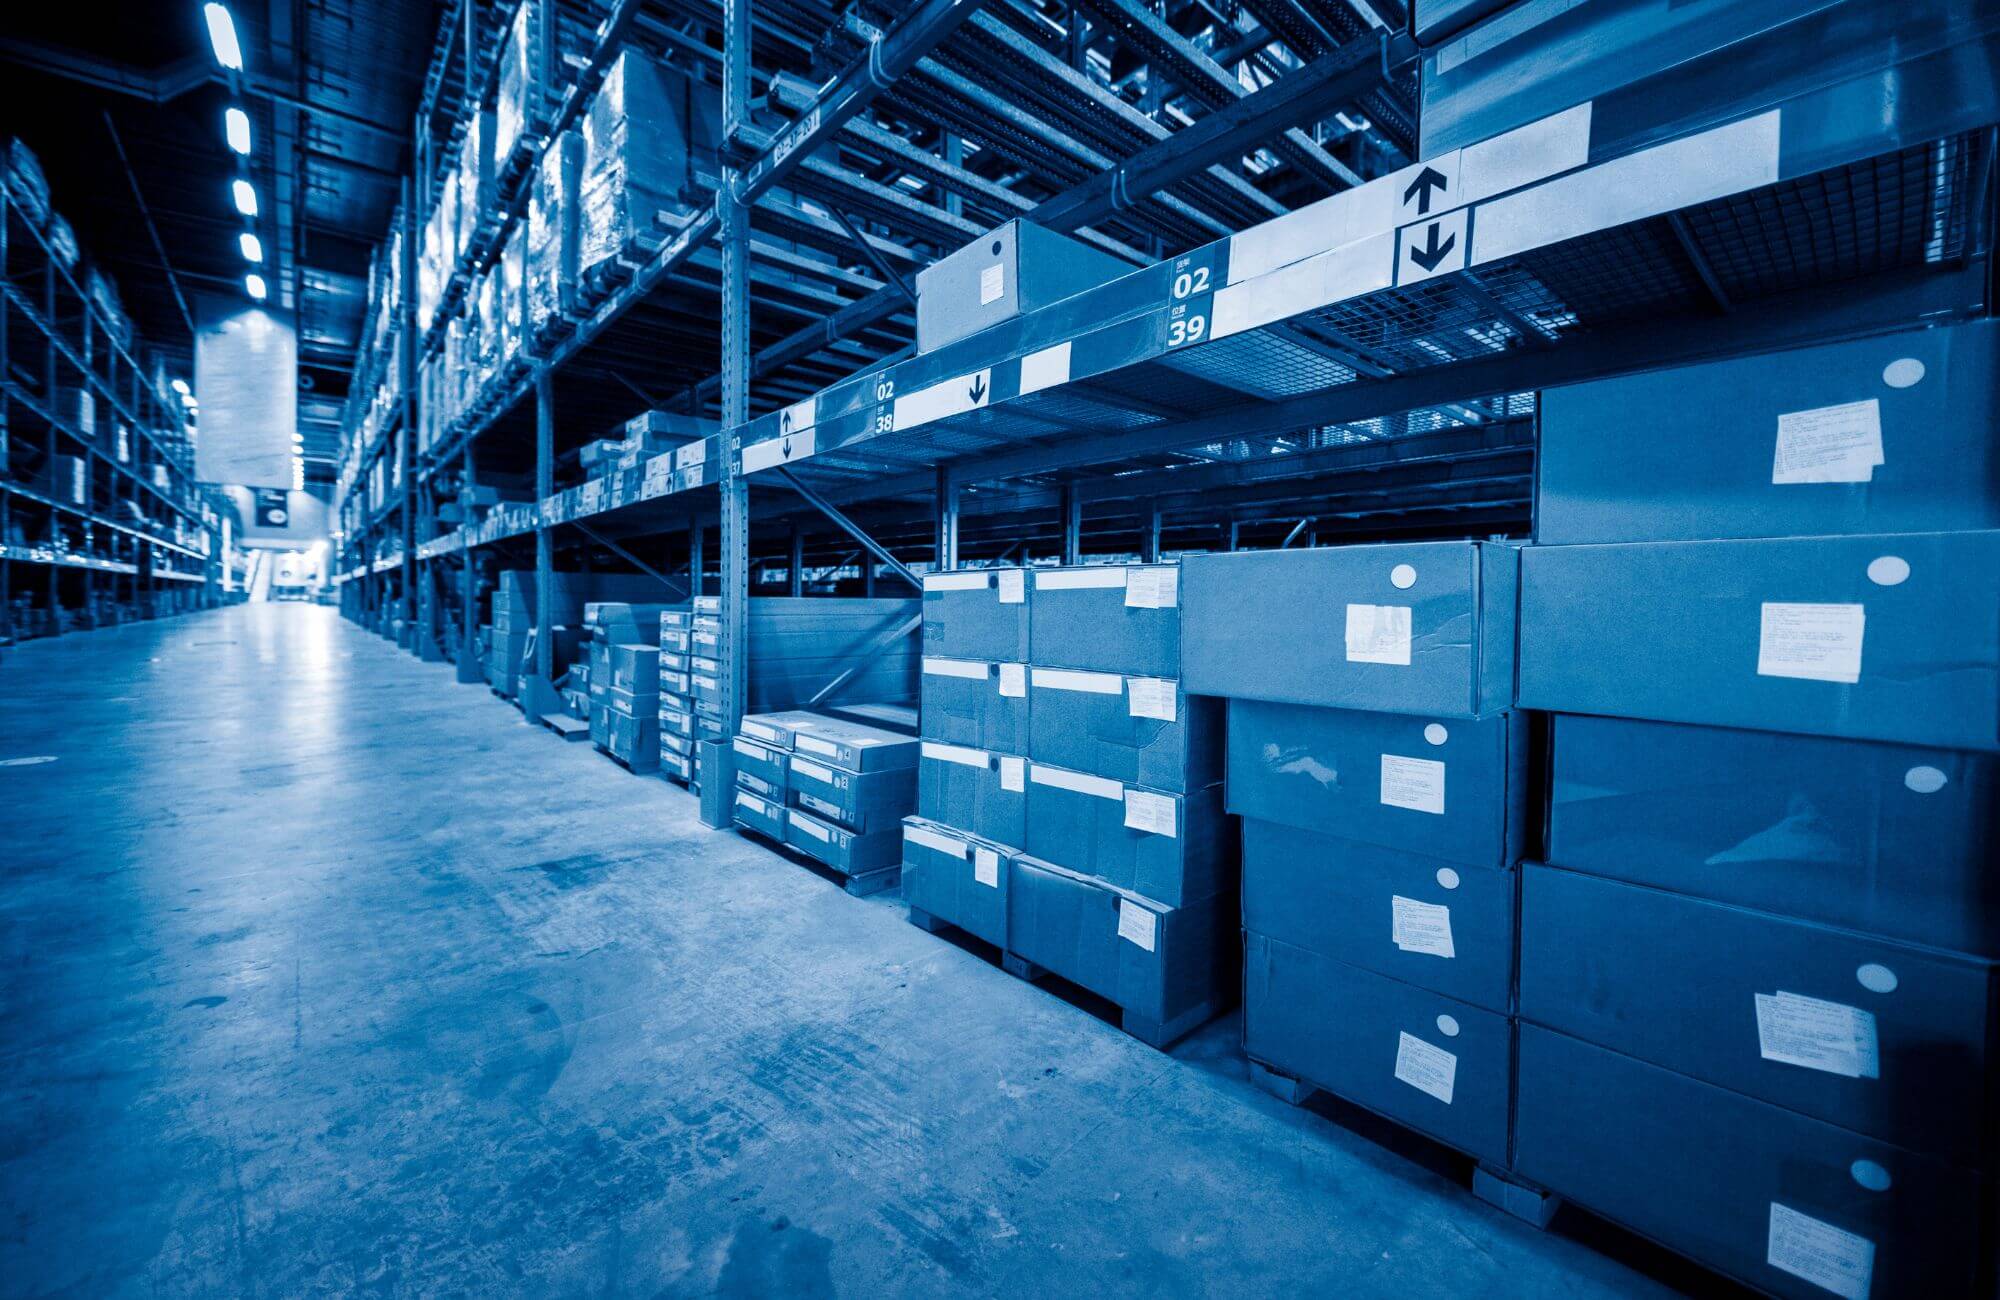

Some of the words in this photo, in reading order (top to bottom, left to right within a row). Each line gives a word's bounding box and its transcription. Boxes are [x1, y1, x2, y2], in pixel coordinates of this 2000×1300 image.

[1174, 267, 1210, 299] 02
[1168, 315, 1205, 346] 39
[877, 381, 894, 401] 02
[875, 414, 893, 434] 38
[731, 436, 741, 450] 02
